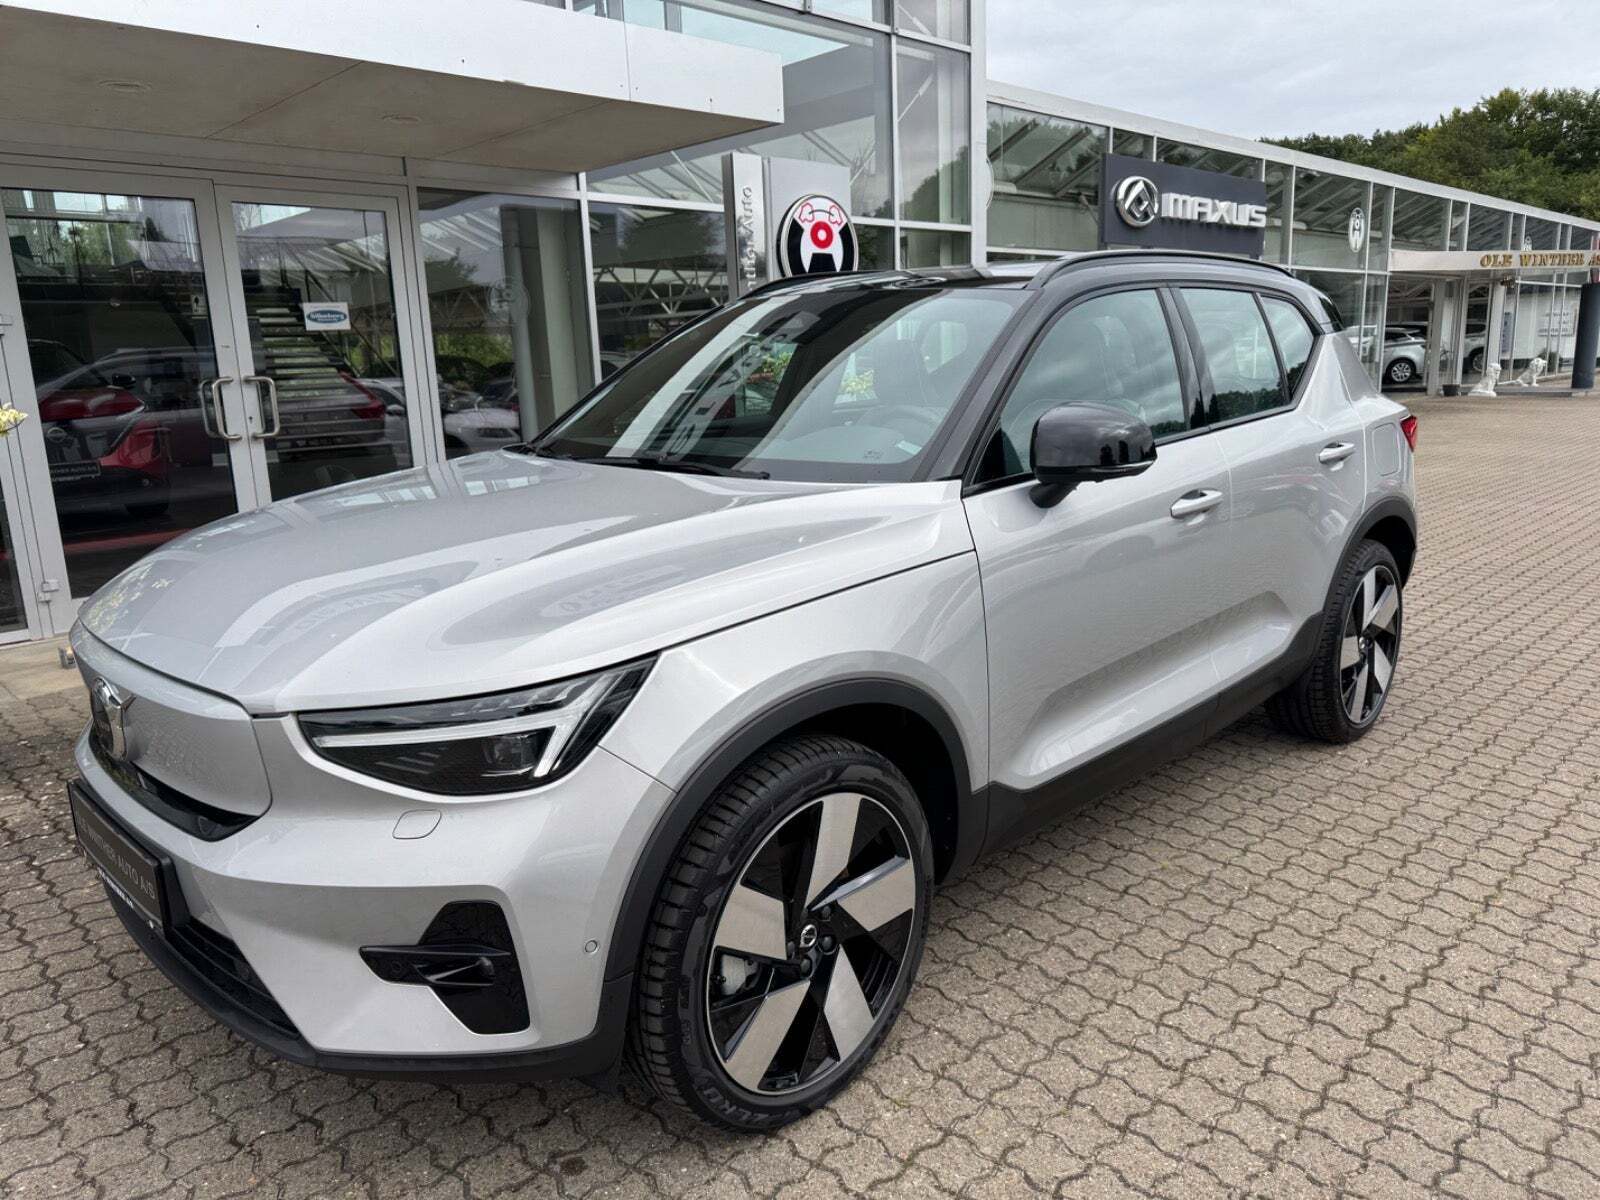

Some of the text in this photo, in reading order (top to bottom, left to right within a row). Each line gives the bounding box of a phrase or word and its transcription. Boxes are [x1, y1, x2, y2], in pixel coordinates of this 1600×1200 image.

[1161, 192, 1267, 228] MAXUS
[1480, 254, 1513, 268] OLE
[1519, 252, 1585, 267] WINTHER
[117, 855, 139, 885] AUTO
